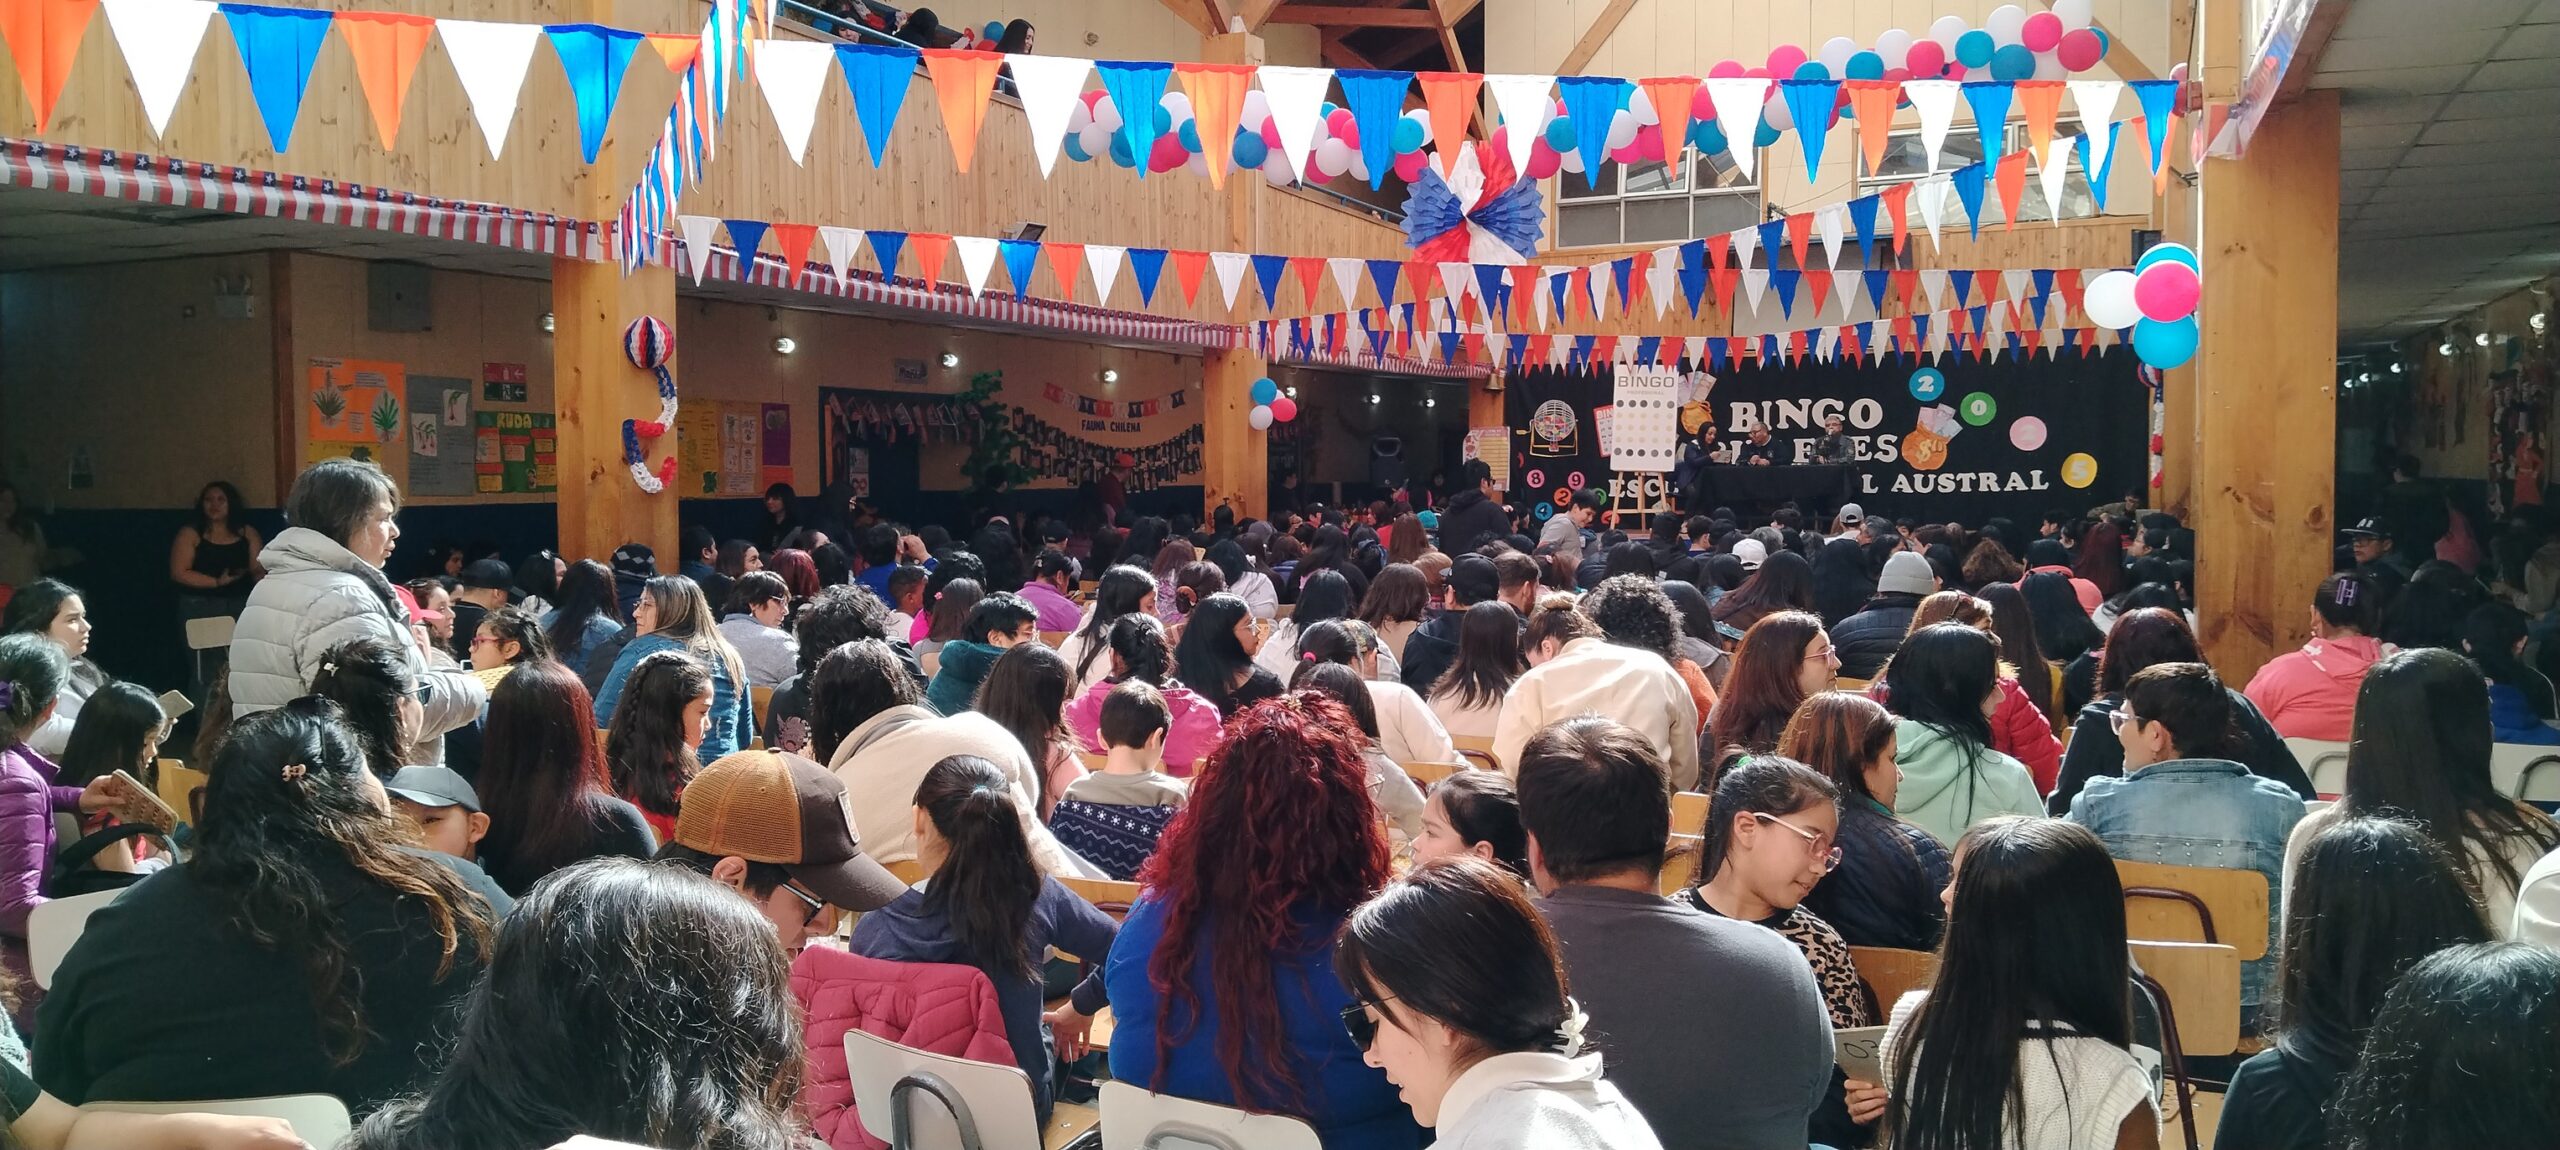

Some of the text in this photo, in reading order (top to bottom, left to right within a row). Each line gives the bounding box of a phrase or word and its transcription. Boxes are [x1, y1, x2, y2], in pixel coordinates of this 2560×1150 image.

[1618, 376, 1675, 388] BINGO
[497, 412, 533, 429] RUDA
[1728, 397, 1884, 433] BINGO
[1081, 419, 1141, 433] FAUNA CHILENA
[1917, 375, 1935, 393] 2
[2071, 460, 2089, 481] 5
[1531, 472, 1541, 485] 8
[1571, 474, 1582, 487] 9
[1891, 470, 2049, 494] AUSTRAL
[1557, 489, 1569, 503] 2
[1538, 504, 1548, 518] 4
